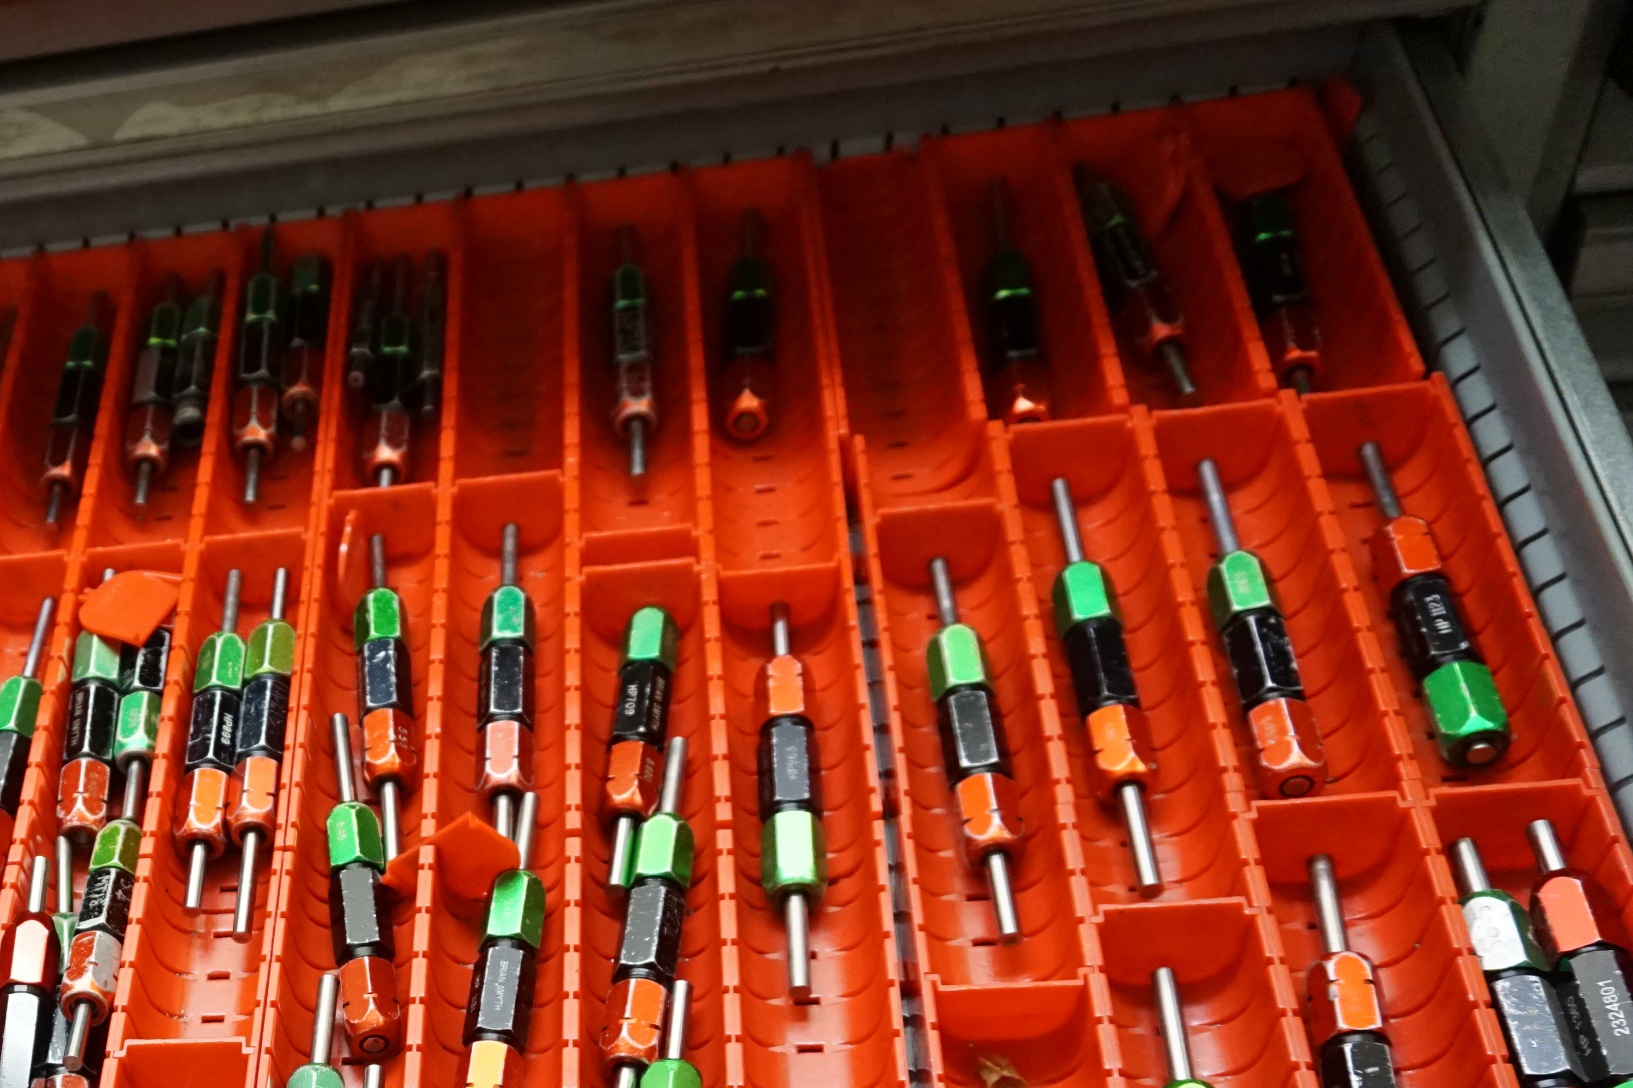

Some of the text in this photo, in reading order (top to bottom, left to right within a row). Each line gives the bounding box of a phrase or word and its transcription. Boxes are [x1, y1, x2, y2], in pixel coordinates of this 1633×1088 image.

[623, 683, 639, 717] HP709
[493, 960, 509, 1012] BRIAN SMYTH
[1596, 978, 1631, 1037] 2324801
